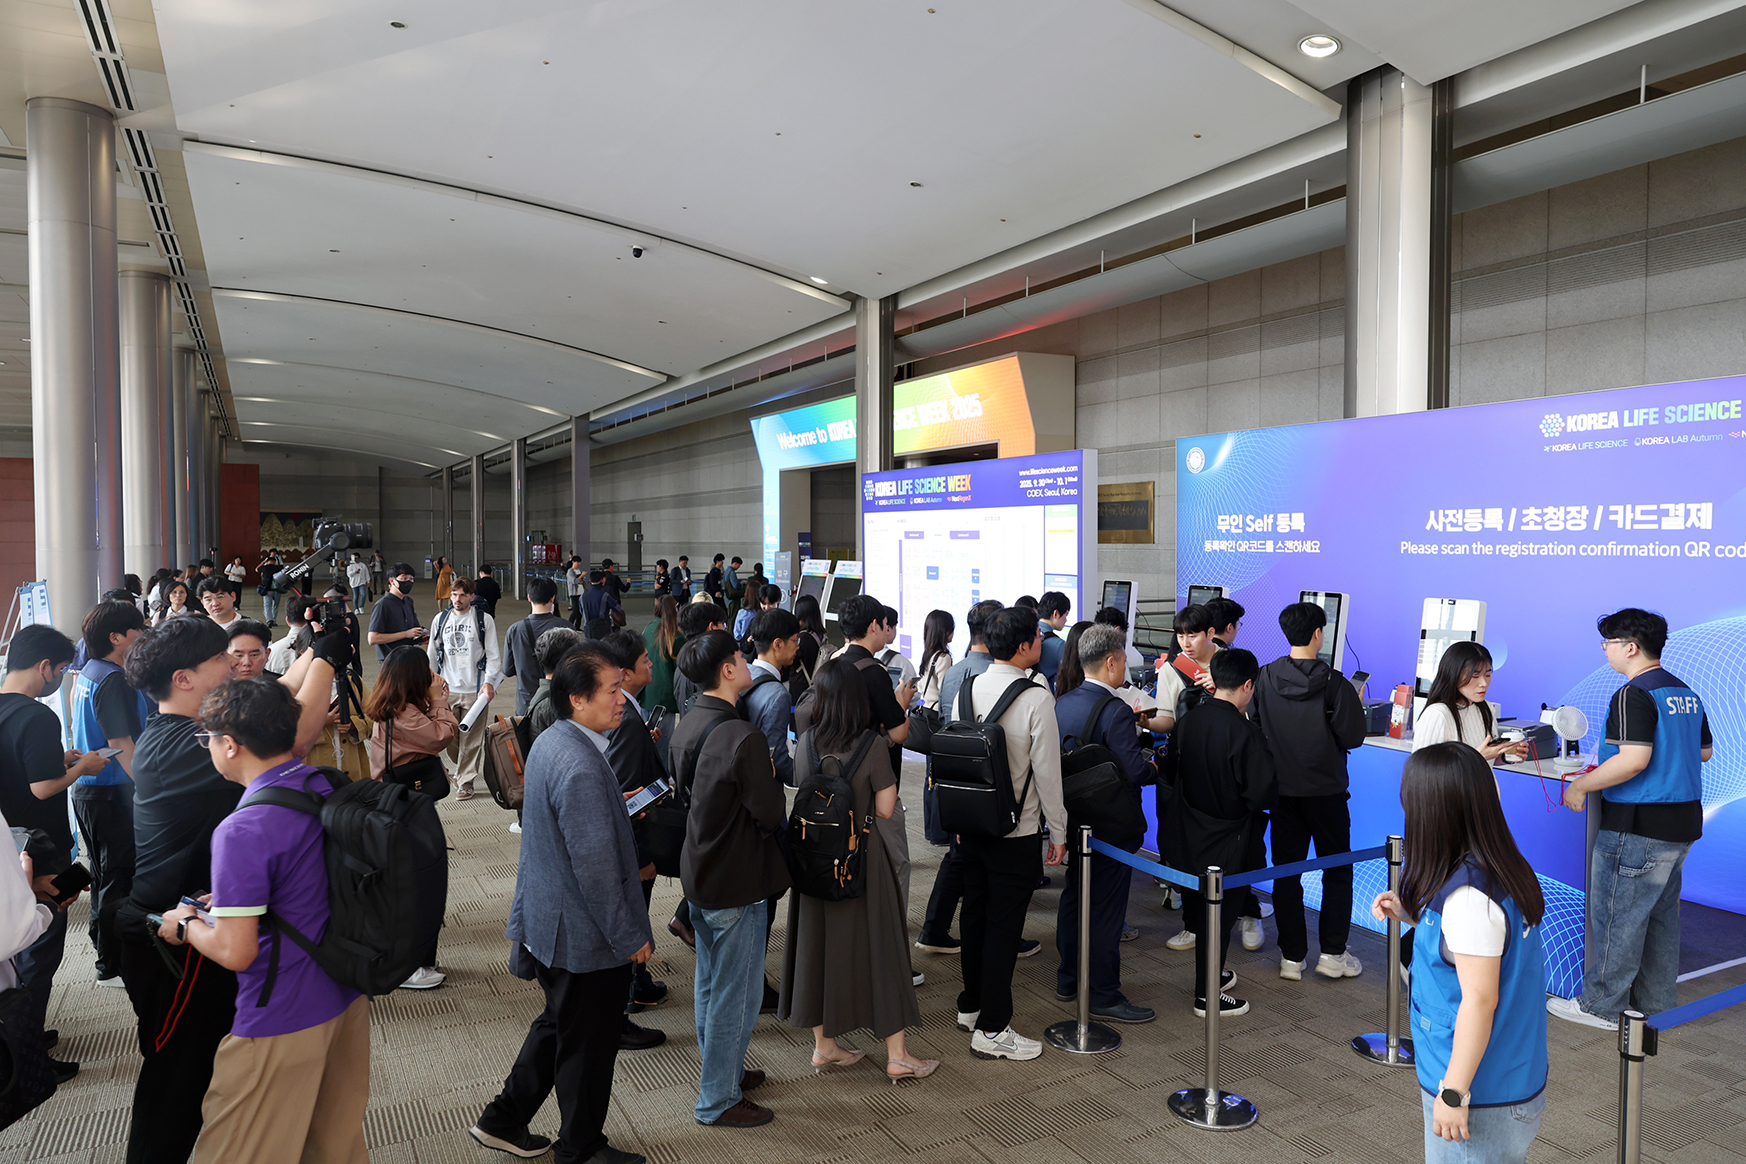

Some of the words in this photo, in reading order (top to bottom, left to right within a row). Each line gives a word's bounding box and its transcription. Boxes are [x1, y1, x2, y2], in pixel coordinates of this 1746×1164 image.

[776, 431, 818, 450] Welcome
[815, 427, 828, 444] to
[826, 419, 857, 442] KOREA
[916, 400, 952, 426] WEEK
[950, 393, 983, 420] 2025
[1566, 410, 1619, 433] KOREA
[1623, 407, 1659, 428] LIFE
[1664, 399, 1742, 424] SCIENCE
[1552, 443, 1577, 452] KOREA
[1578, 441, 1594, 450] LIFE
[1594, 439, 1629, 449] SCIENCE
[1641, 436, 1670, 446] KOREA
[1671, 434, 1689, 444] LAB
[1690, 434, 1723, 442] Autumn
[875, 480, 897, 497] KOREA
[898, 479, 913, 495] LIFE
[914, 476, 946, 494] SCIENCE
[947, 474, 972, 492] WEEK
[1061, 487, 1078, 496] Korea
[1217, 514, 1243, 533] 무인
[1245, 514, 1274, 533] Self
[1276, 512, 1306, 533] 등록
[1425, 507, 1504, 532] 사전등록
[1507, 507, 1517, 532] /
[1520, 506, 1589, 532] 초청장
[1593, 504, 1604, 531] /
[1608, 502, 1713, 530] 카드결제
[1204, 540, 1236, 552] 등록확인
[1236, 540, 1274, 553] QR코드를
[1275, 540, 1321, 553] 스캔하세요
[1400, 541, 1439, 555] Please
[1440, 543, 1470, 555] scan
[1472, 541, 1493, 555] the
[1495, 541, 1576, 558] registration
[1579, 541, 1681, 557] confirmation
[1684, 541, 1711, 558] QR
[290, 563, 310, 579] RONIN
[777, 569, 788, 578] 입구
[1666, 696, 1699, 715] STAFF
